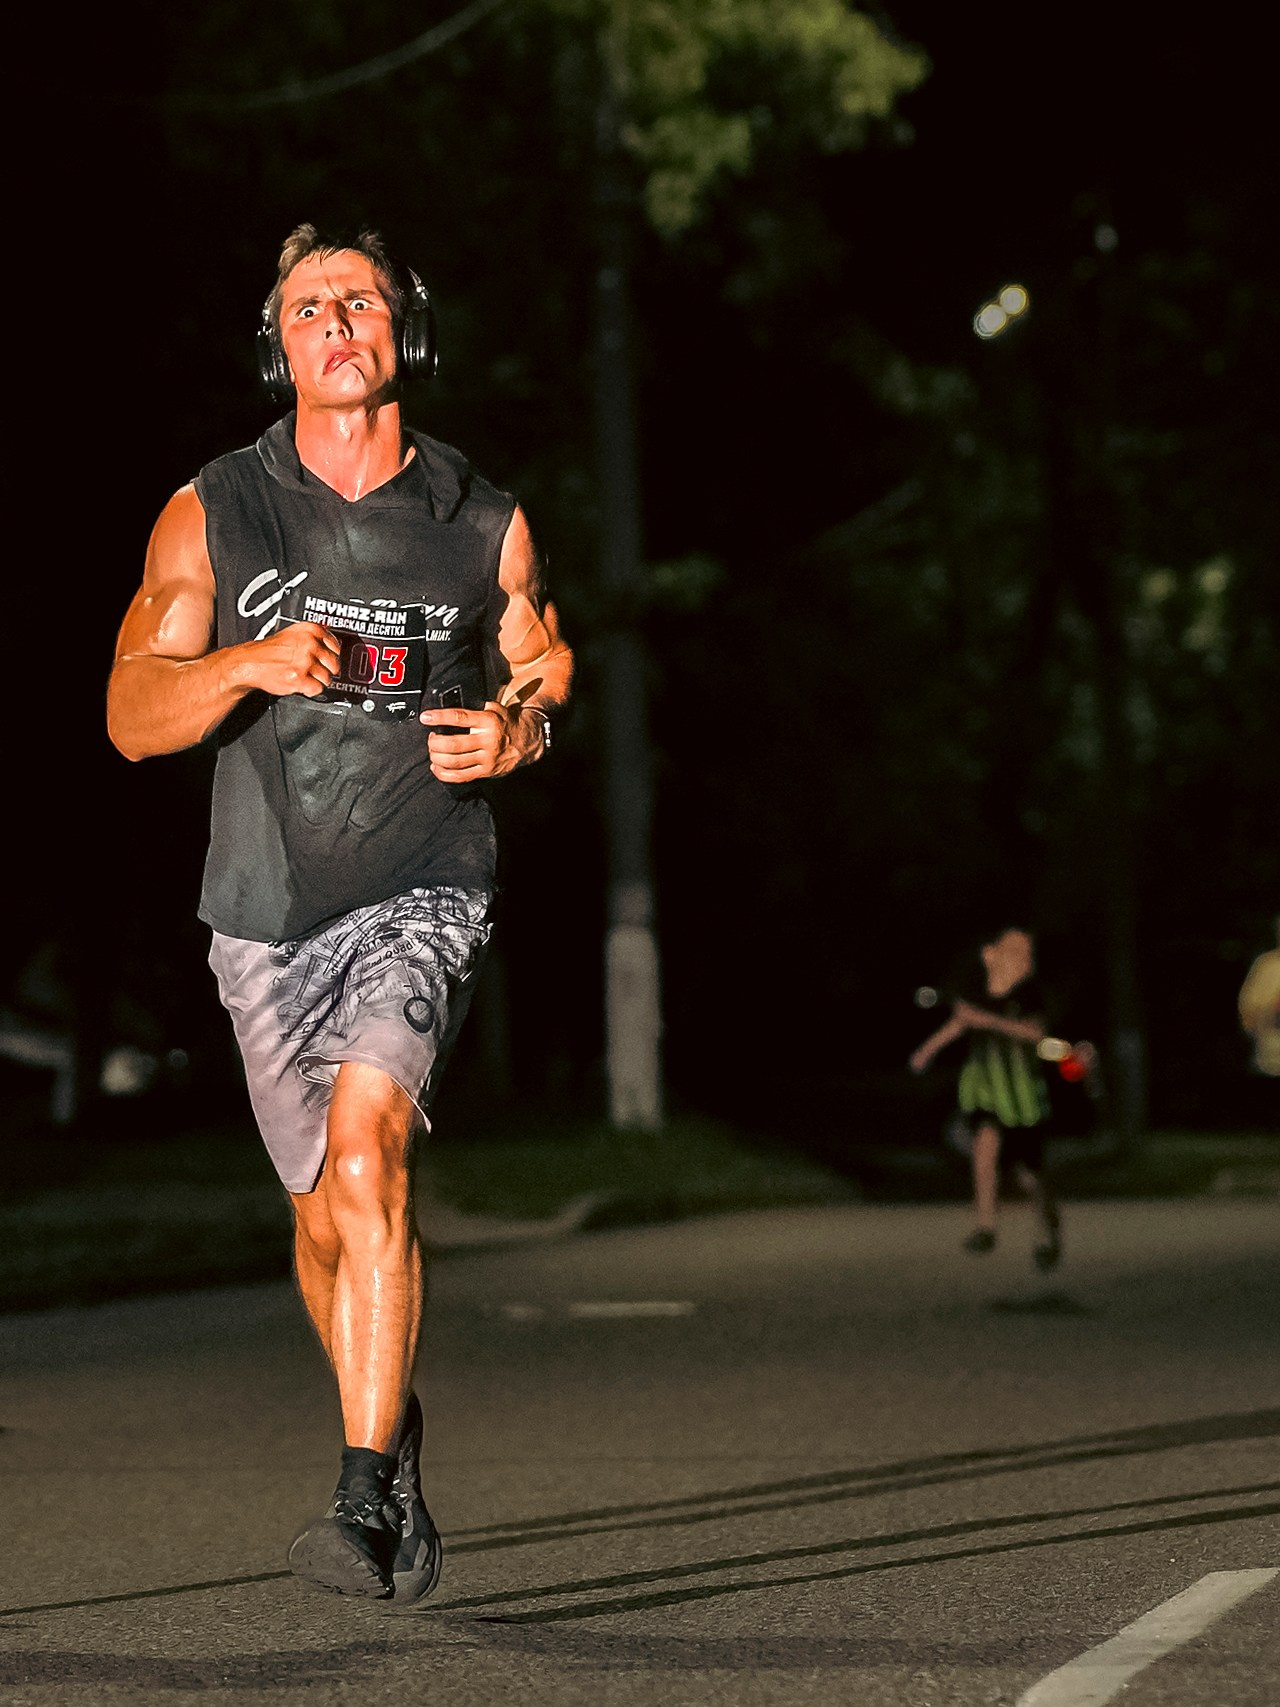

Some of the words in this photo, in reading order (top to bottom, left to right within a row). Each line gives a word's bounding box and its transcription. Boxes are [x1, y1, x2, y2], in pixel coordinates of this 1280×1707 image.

[303, 609, 366, 632] ГЕОРГИЕВСКАЯ
[366, 622, 405, 637] ДЕСЯТКА
[334, 643, 409, 687] 03
[326, 681, 368, 695] ЕСЯТКА
